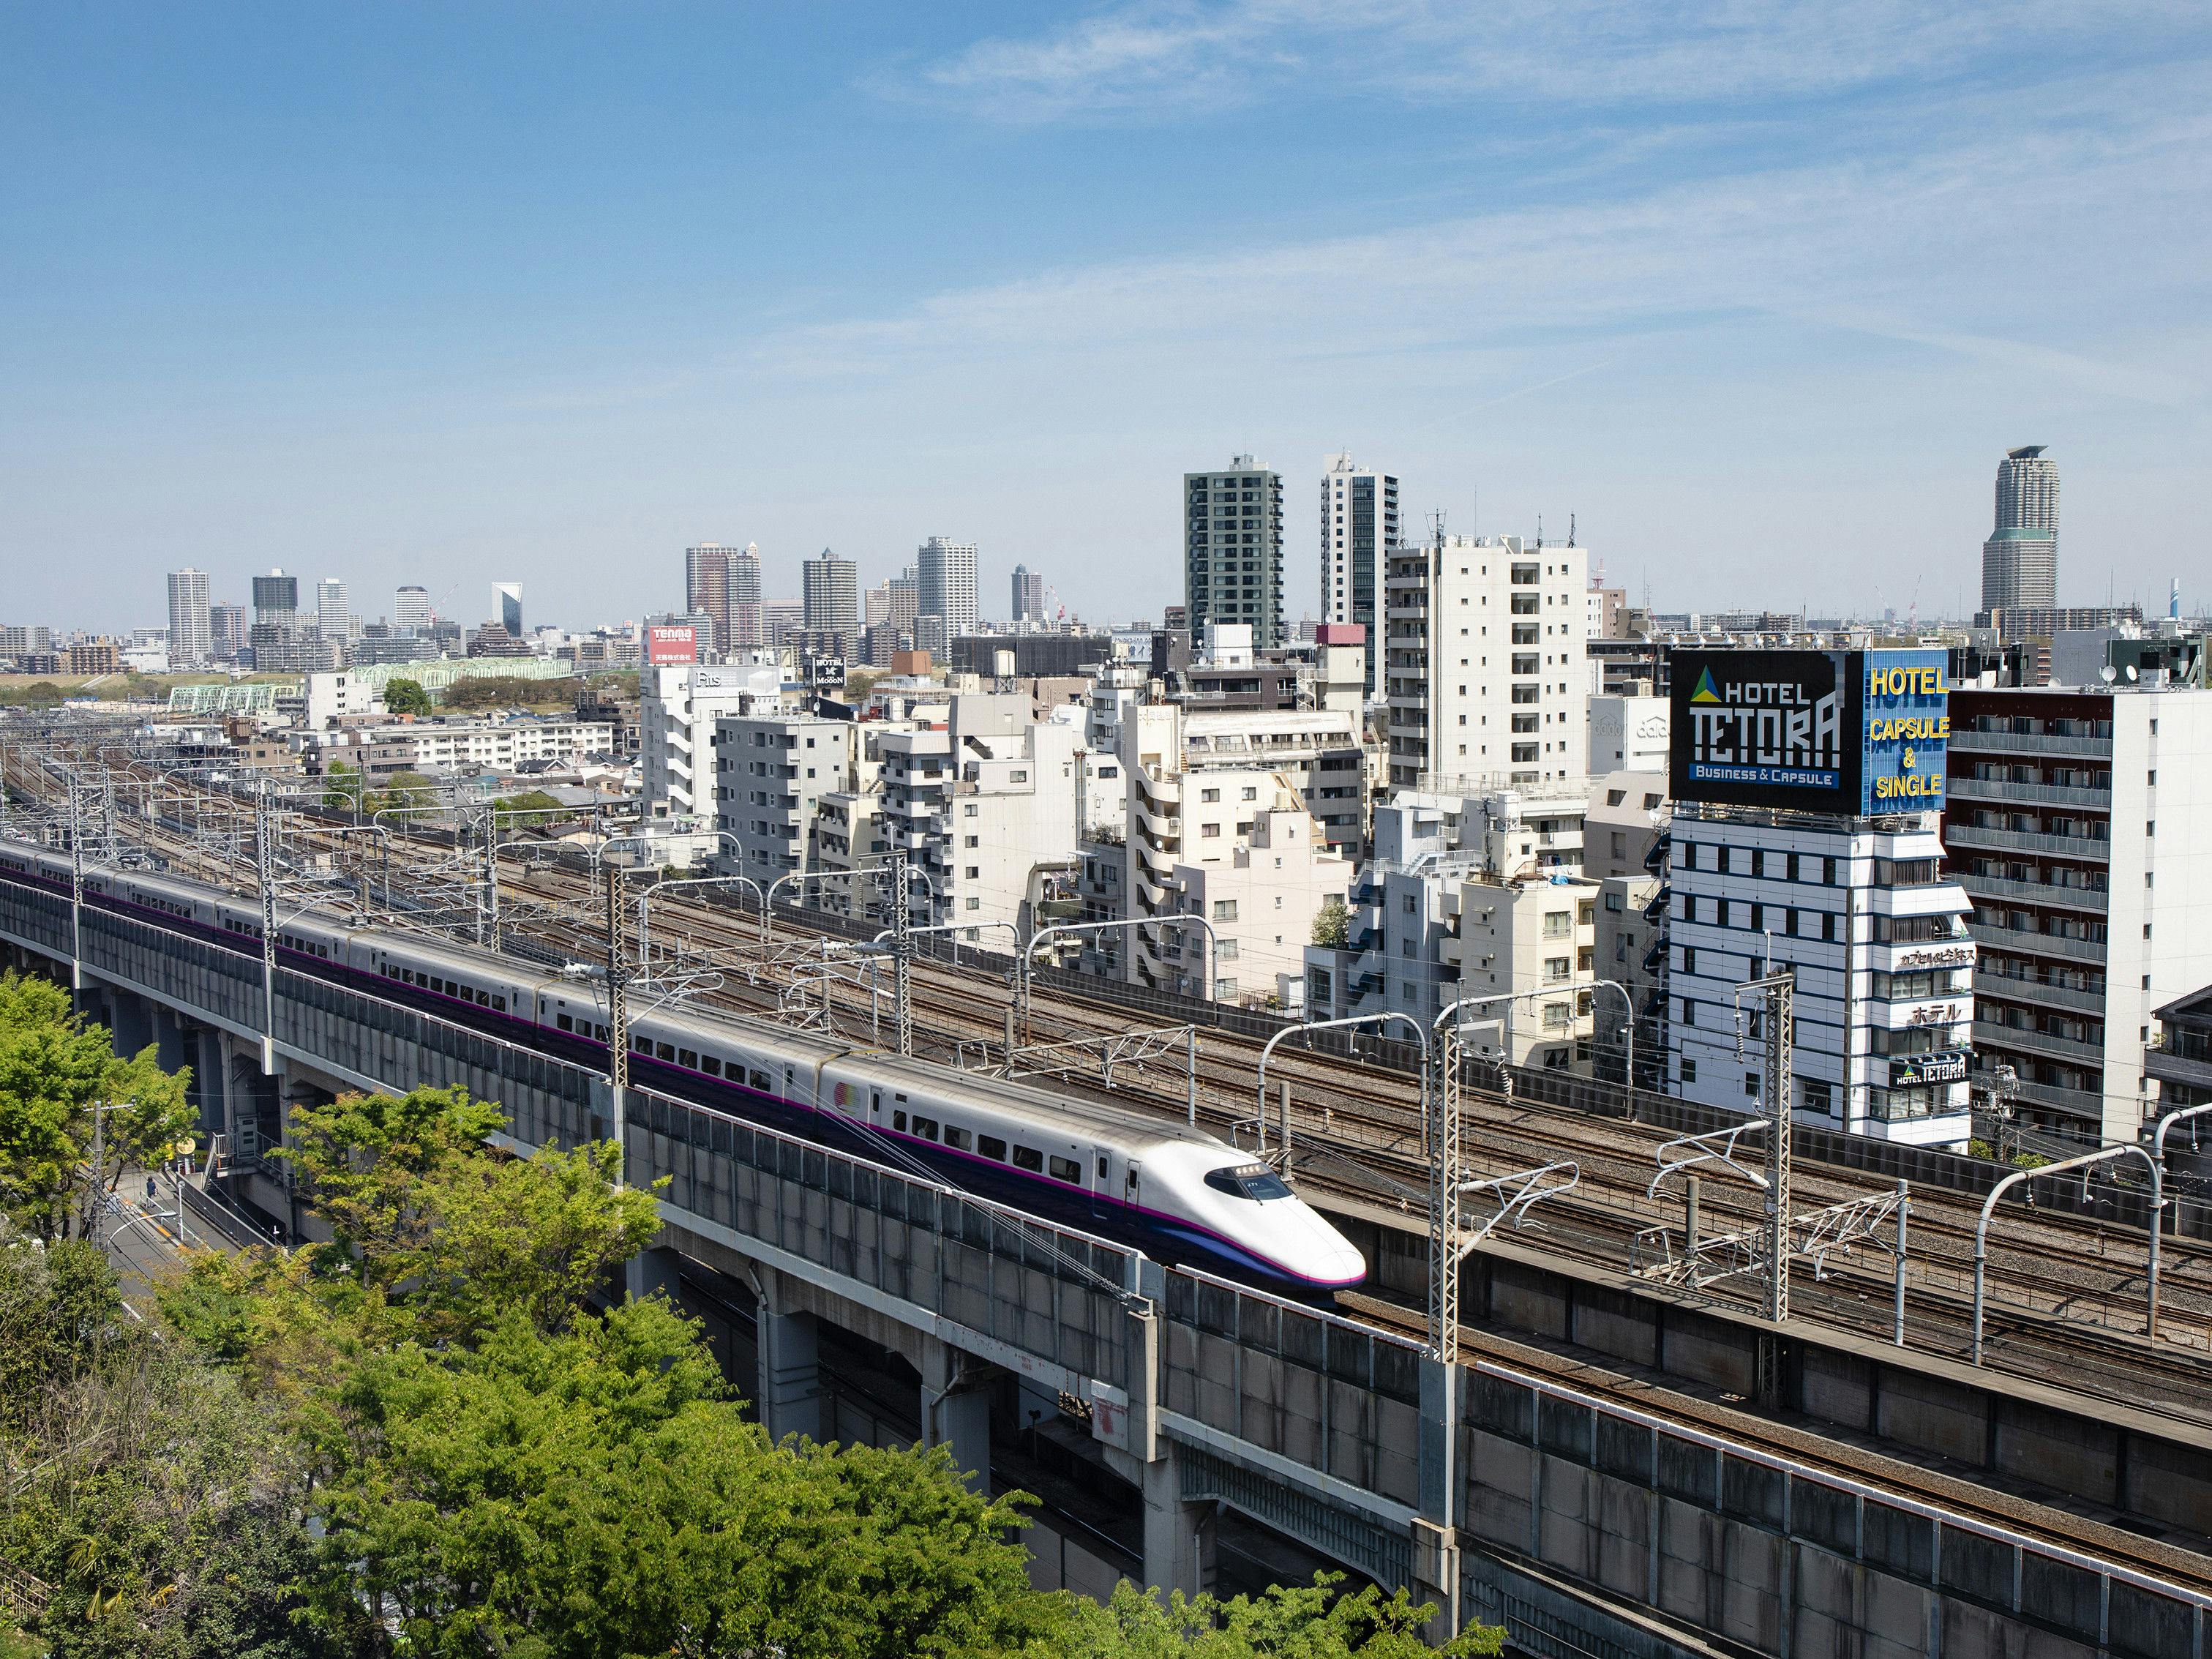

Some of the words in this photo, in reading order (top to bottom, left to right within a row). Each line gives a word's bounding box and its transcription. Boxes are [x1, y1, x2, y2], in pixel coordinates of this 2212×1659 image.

[696, 672, 721, 687] Fits
[1871, 667, 1949, 695] HOTEL
[1725, 683, 1811, 704] HOTEL
[1690, 690, 1840, 768] TETORA
[1870, 717, 1950, 741] CAPSULE
[1903, 747, 1916, 768] &
[1759, 768, 1768, 781] &
[1876, 774, 1942, 798] SINGLE
[1911, 1004, 1961, 1023] ホテル
[1922, 1057, 1965, 1082] TETORA
[1897, 1076, 1922, 1085] HOTEL
